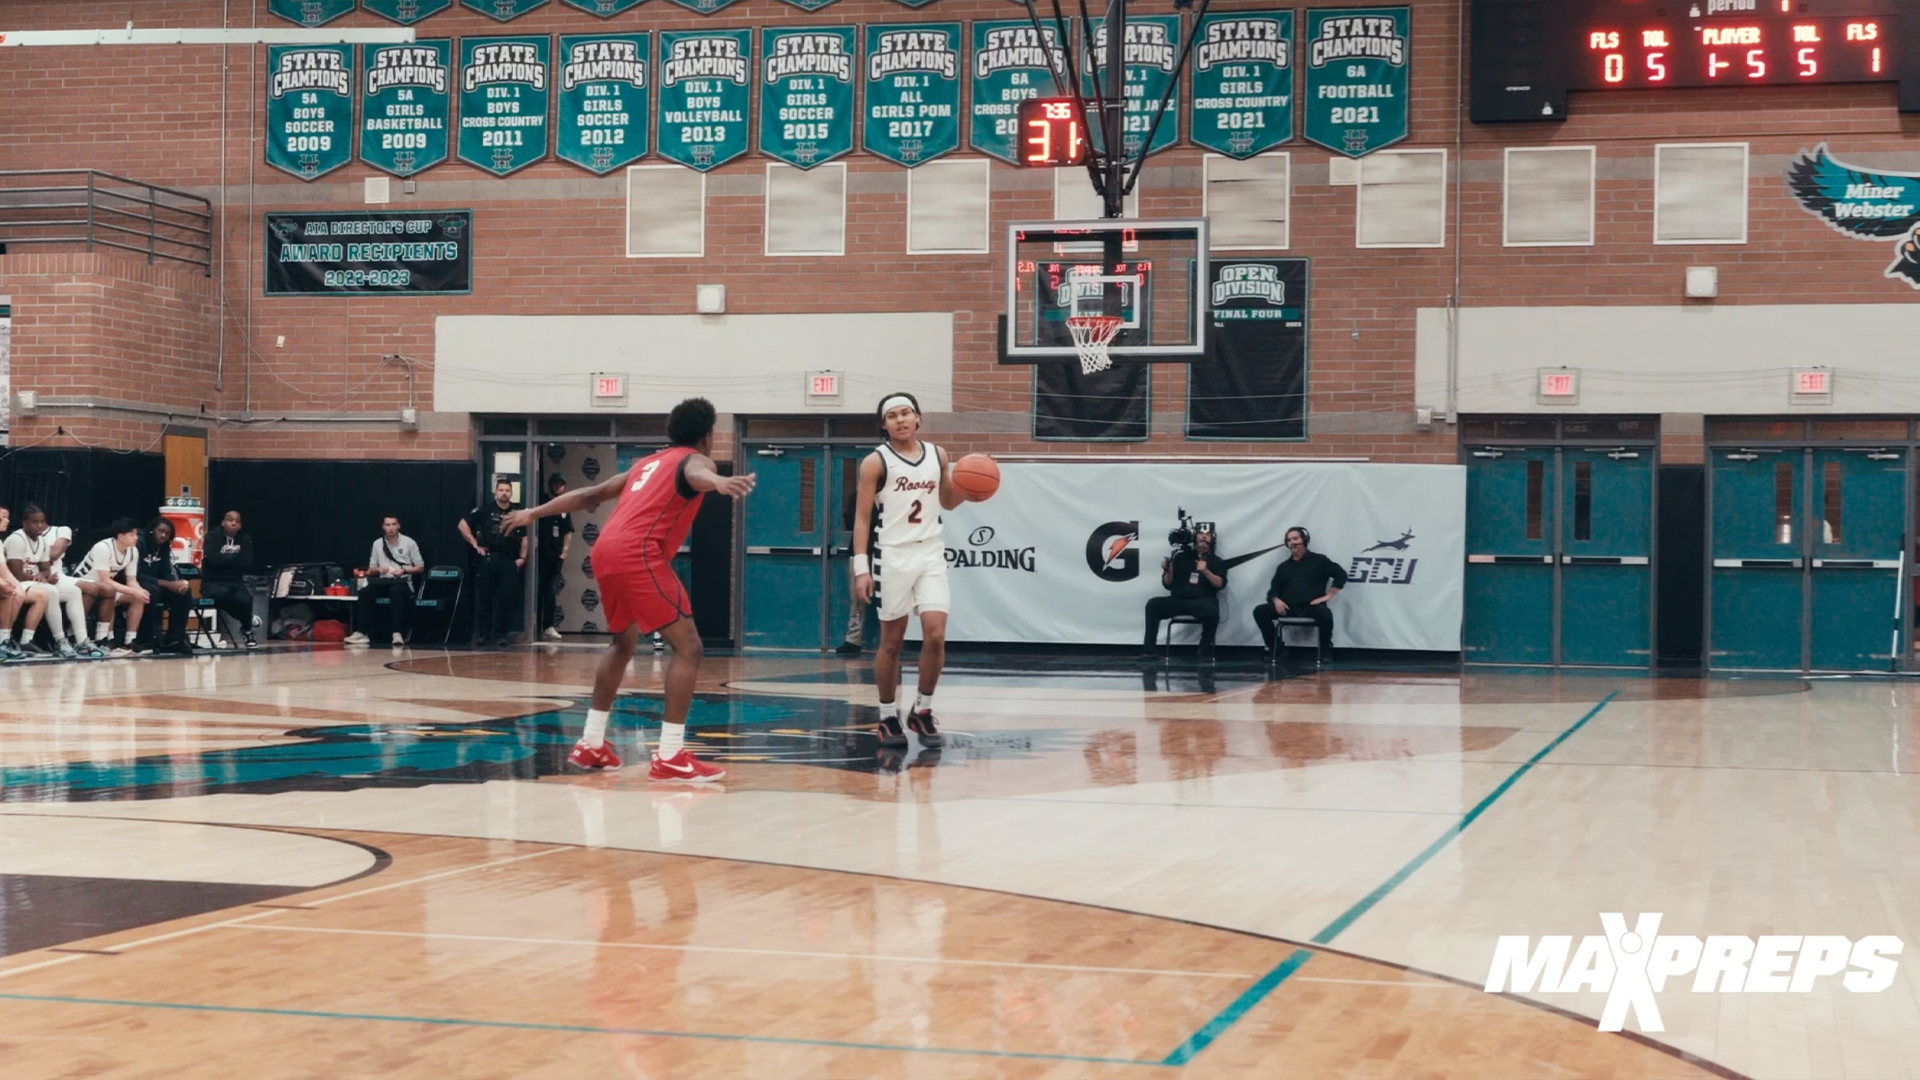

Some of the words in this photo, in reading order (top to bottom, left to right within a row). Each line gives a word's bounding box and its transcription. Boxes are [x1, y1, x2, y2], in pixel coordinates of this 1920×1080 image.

[1096, 25, 1164, 46] SATE
[1208, 22, 1277, 42] STATE
[1323, 18, 1393, 39] STATE
[1590, 32, 1619, 49] FLS
[1703, 27, 1760, 45] PLAYER
[1847, 23, 1877, 40] FLS
[674, 39, 737, 60] STATE
[776, 36, 840, 57] STATE
[881, 33, 946, 53] STATE
[377, 49, 436, 68] STATE
[474, 45, 535, 65] STATE
[573, 43, 635, 63] STATE
[1199, 39, 1286, 70] CHAMPIONS
[1313, 37, 1402, 66] CHAMPIONS
[281, 52, 340, 71] STATE
[767, 54, 849, 82] CHAMPIONS
[871, 51, 955, 79] CHAMPIONS
[1605, 54, 1623, 82] 0
[1647, 53, 1665, 81] 5
[1798, 48, 1817, 76] 5
[1872, 47, 1880, 73] 1
[465, 63, 544, 90] CHAMPIONS
[564, 61, 643, 89] CHAMPIONS
[665, 57, 745, 85] CHAMPIONS
[1011, 73, 1029, 85] 6A
[1141, 69, 1147, 80] 1
[1222, 67, 1249, 78] DIV.
[1253, 66, 1260, 77] 1
[1346, 65, 1366, 77] 6A
[274, 69, 348, 97] CHAMPIONS
[369, 66, 445, 94] CHAMPIONS
[685, 82, 712, 93] DIV.
[716, 81, 723, 92] 1
[789, 79, 814, 90] DIV.
[818, 78, 825, 89] 1
[894, 76, 919, 88] DIV.
[923, 76, 929, 87] 1
[1219, 81, 1263, 94] GIRLS
[302, 93, 318, 104] 5A
[397, 89, 413, 101] 5A
[487, 87, 511, 98] DIV.
[514, 87, 520, 98] 1
[586, 85, 610, 97] DIV.
[613, 84, 620, 96] 1
[900, 91, 923, 103] ALL
[1002, 87, 1037, 101] BOYS
[1124, 84, 1144, 97] OM
[1318, 84, 1394, 99] FOOTBALL
[583, 99, 623, 112] GIRLS
[687, 96, 721, 109] BOYS
[786, 93, 827, 106] GIRLS
[1144, 99, 1174, 111] JAZ
[1195, 97, 1233, 109] CROSS
[1235, 95, 1289, 108] COUNTRY
[293, 107, 325, 119] BOYS
[386, 104, 424, 116] GIRLS
[487, 102, 520, 114] BOYS
[779, 107, 834, 120] SOCCER
[872, 105, 914, 118] GIRLS
[919, 104, 951, 117] POM
[974, 104, 1011, 116] CROSS
[1330, 106, 1380, 124] 2021
[366, 118, 443, 130] BASKETBALL
[462, 117, 495, 127] CROSS
[497, 115, 544, 127] COUNTRY
[577, 113, 629, 126] SOCCER
[665, 110, 742, 123] VOLLEYBALL
[1217, 112, 1265, 129] 2021
[285, 121, 334, 133] SOCCER
[681, 126, 726, 142] 2013
[783, 123, 829, 140] 2015
[889, 121, 933, 137] 2017
[996, 118, 1018, 135] 20
[287, 136, 331, 152] 2009
[382, 133, 426, 149] 2009
[482, 130, 523, 146] 2011
[580, 129, 625, 145] 2012
[1028, 120, 1077, 160] 31
[1844, 182, 1905, 199] Miner
[1834, 201, 1914, 218] Webster
[304, 222, 328, 236] AIA
[331, 220, 404, 235] DIRECTOR'S
[406, 220, 432, 234] CUP
[280, 243, 343, 262] AWARD
[347, 241, 457, 261] RECIPIENTS
[324, 269, 411, 286] 2022-2023
[1222, 267, 1275, 282] OPEN
[1215, 280, 1282, 303] DIVISION
[1213, 309, 1248, 318] FINAL
[1251, 309, 1282, 318] FOUR
[599, 378, 619, 395] EXIT
[814, 377, 835, 392] EXIT
[1547, 375, 1571, 392] EXIT
[1800, 374, 1824, 391] EXIT
[631, 460, 660, 492] 3
[908, 499, 922, 524] 2
[944, 546, 1036, 573] PALDING
[1347, 557, 1419, 584] GCU
